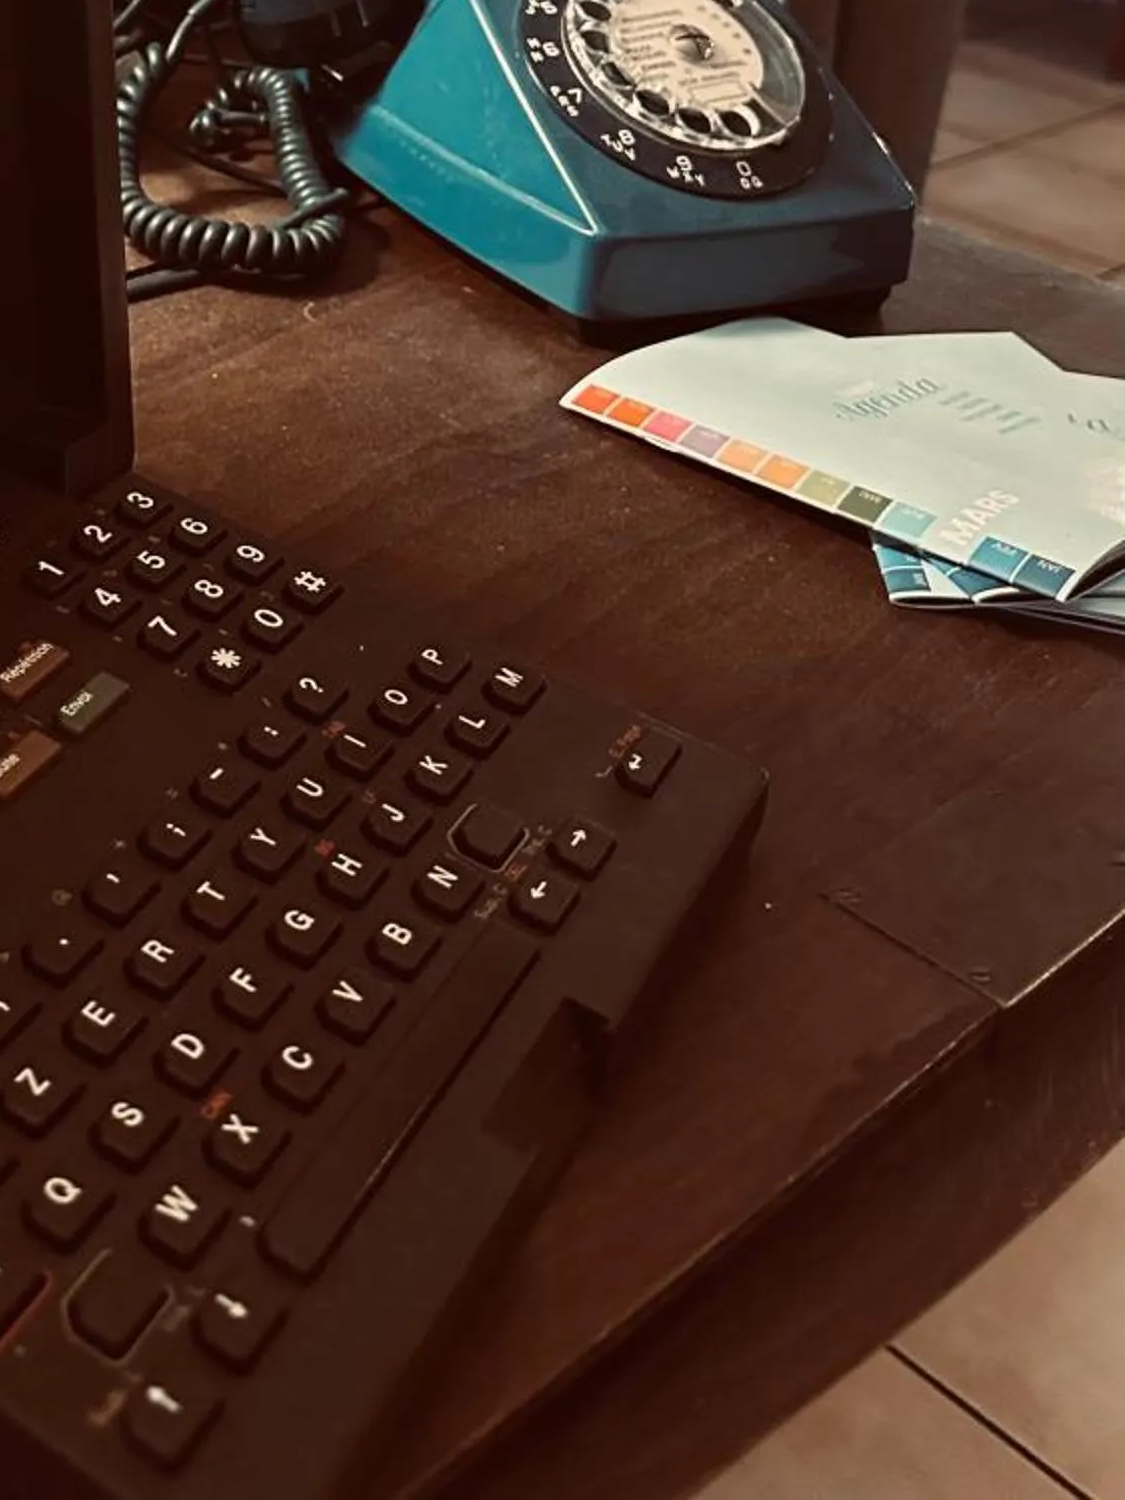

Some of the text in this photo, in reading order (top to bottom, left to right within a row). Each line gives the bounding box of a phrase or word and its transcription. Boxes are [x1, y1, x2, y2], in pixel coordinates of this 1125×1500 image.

[542, 41, 560, 57] 6
[567, 87, 582, 105] 7
[618, 129, 635, 146] 8
[676, 155, 692, 171] 9
[127, 492, 153, 508] 3
[181, 518, 208, 534] 6
[939, 489, 1020, 547] MARS
[84, 525, 112, 543] 2
[137, 551, 165, 569] 5
[237, 546, 265, 562] 9
[39, 561, 64, 575] 1
[194, 580, 223, 598] 8
[294, 571, 326, 592] #
[95, 588, 121, 606] 4
[148, 616, 177, 636] 7
[254, 609, 283, 628] 0
[422, 649, 443, 665] P
[299, 678, 323, 692] ?
[495, 668, 523, 687] M
[385, 690, 408, 705] O
[459, 716, 485, 728] L
[344, 735, 366, 747] I
[419, 756, 448, 775] K
[297, 778, 323, 797] U
[382, 804, 405, 822] J
[250, 828, 276, 846] Y
[331, 854, 362, 876] H
[427, 865, 458, 888] N
[197, 881, 225, 900] T
[285, 910, 314, 930] G
[382, 923, 412, 945] B
[141, 940, 174, 963] R
[229, 968, 256, 992] F
[332, 981, 363, 1002] V
[81, 1001, 115, 1026] E
[171, 1034, 204, 1059] D
[282, 1046, 313, 1069] C
[14, 1068, 51, 1096] Z
[111, 1102, 144, 1127] S
[221, 1114, 259, 1144] X
[44, 1178, 81, 1204] Q
[155, 1186, 197, 1221] W
